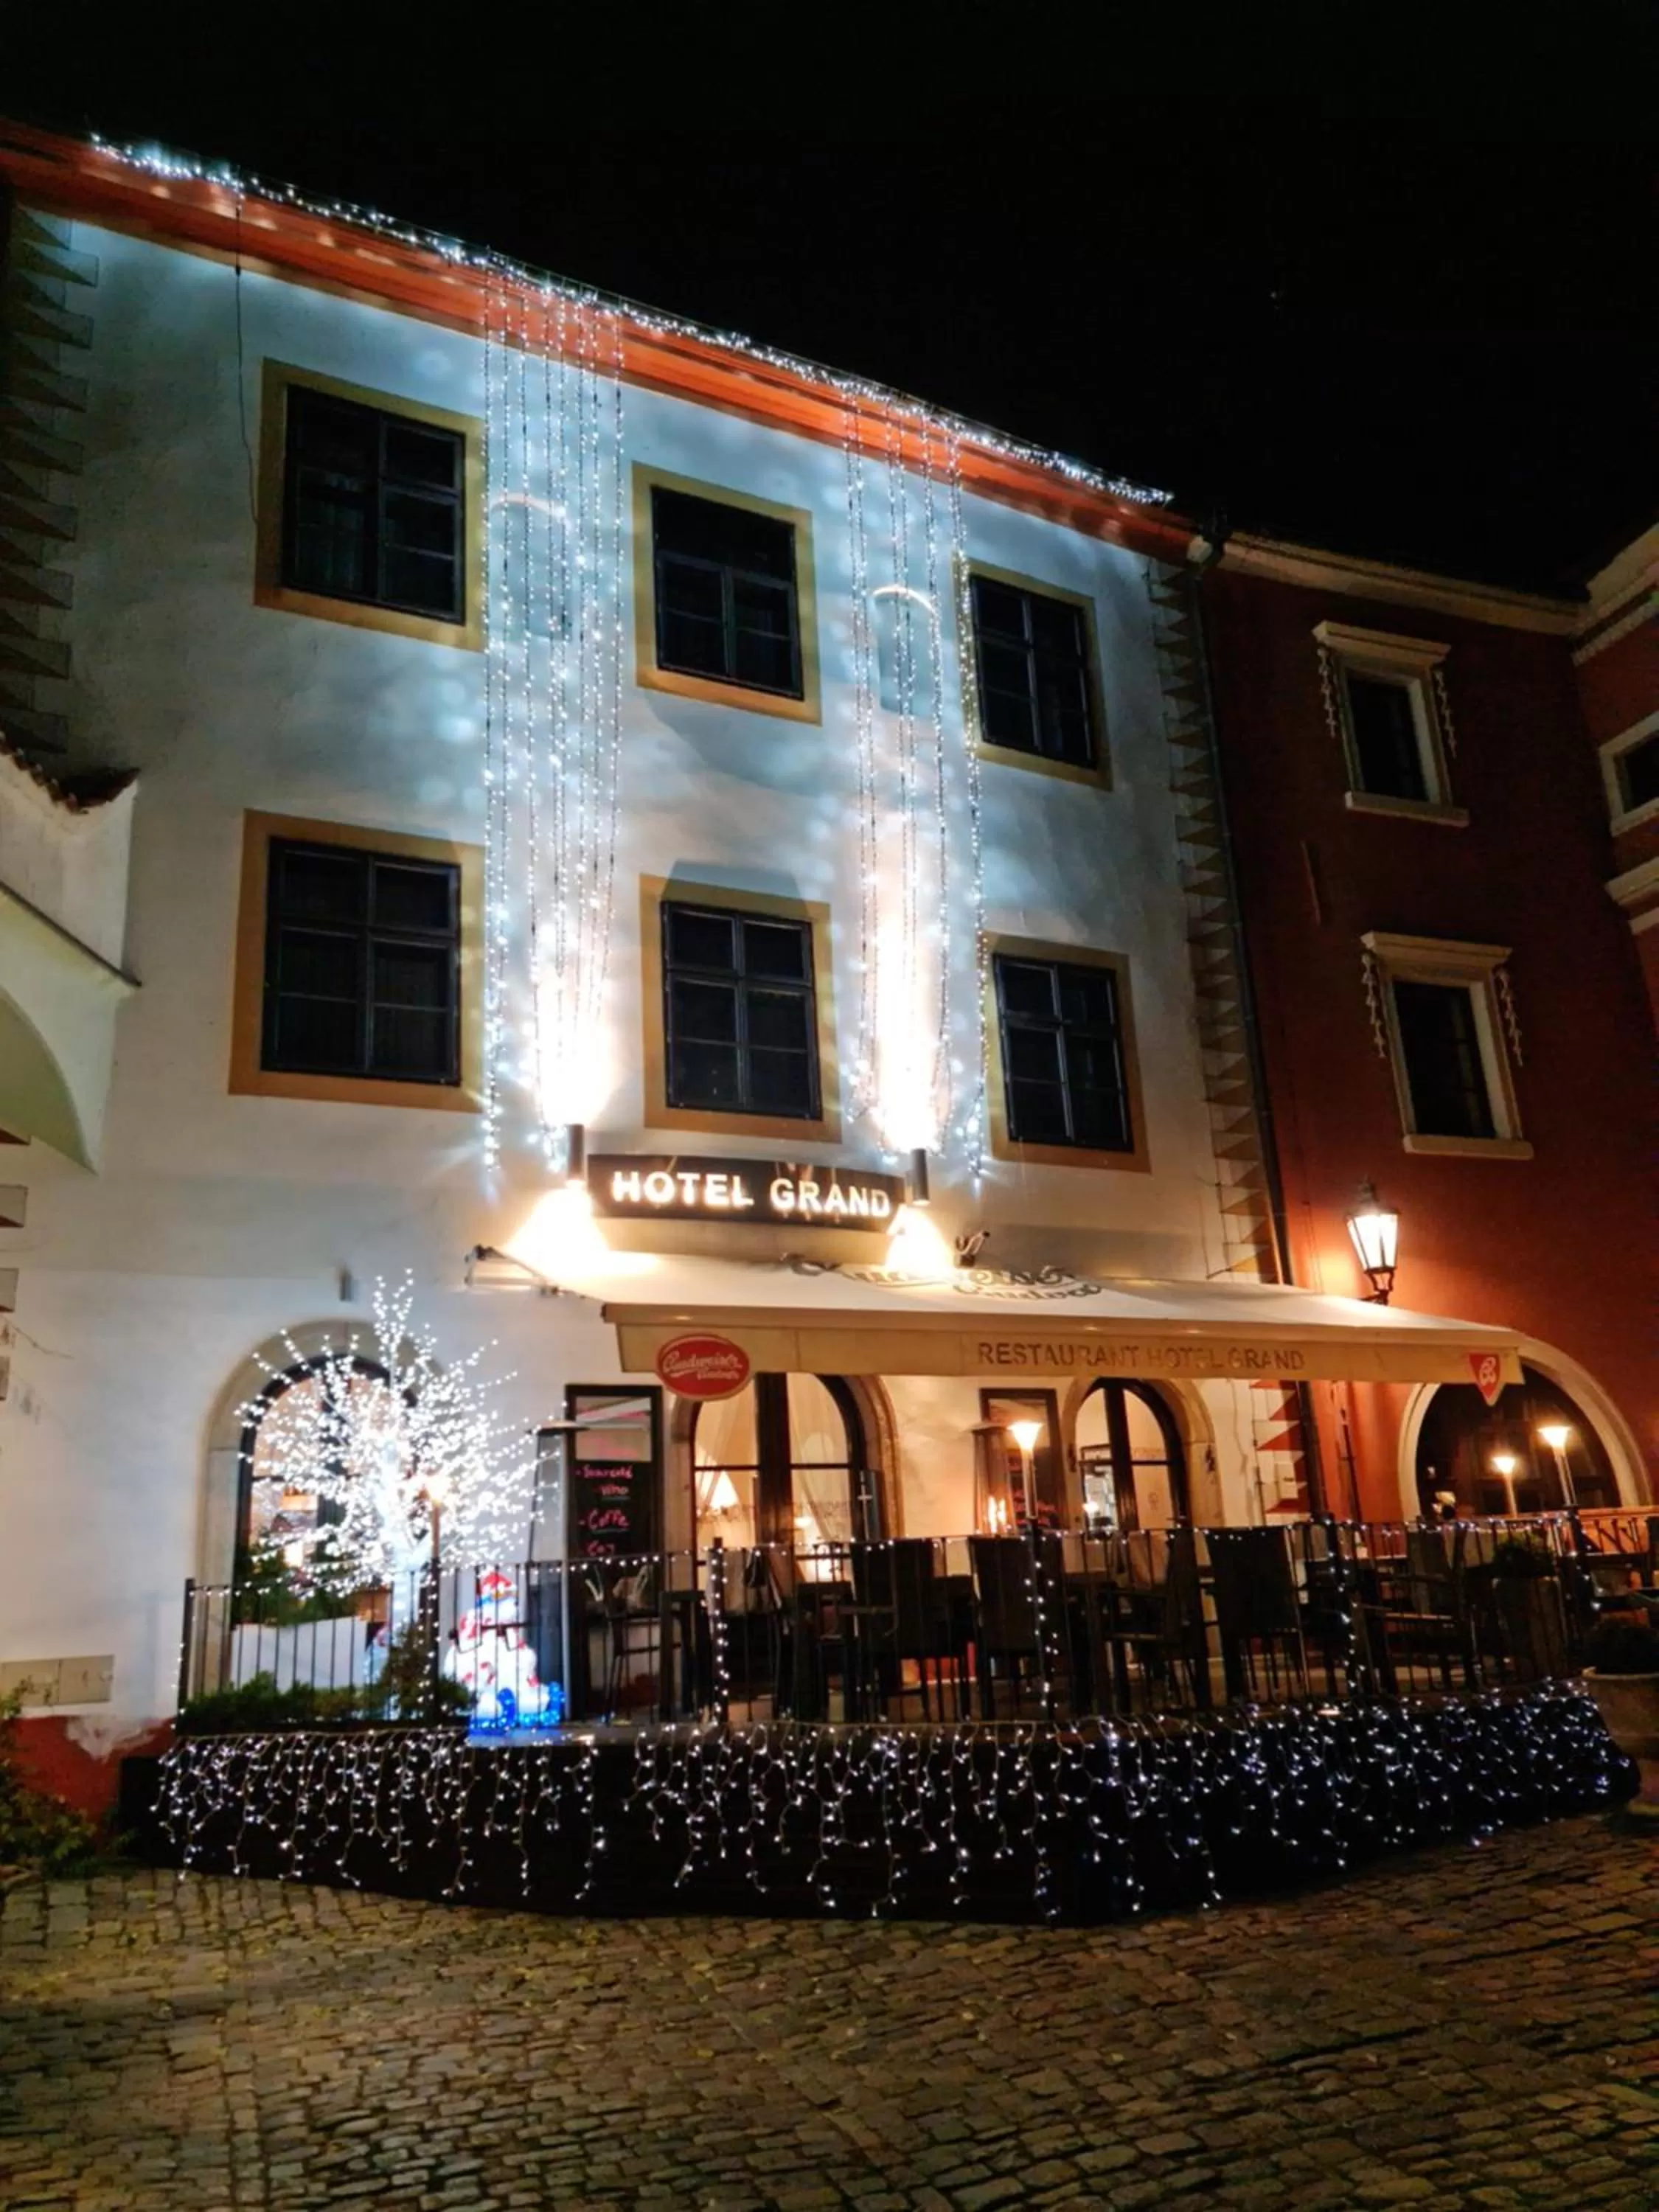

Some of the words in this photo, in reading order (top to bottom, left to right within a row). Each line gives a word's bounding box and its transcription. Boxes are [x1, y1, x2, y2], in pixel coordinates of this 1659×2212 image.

[611, 1170, 754, 1207] HOTEL
[770, 1178, 891, 1218] GRAND
[978, 1342, 1139, 1368] RESTAURANT
[1147, 1346, 1223, 1369] HOTEL
[1227, 1348, 1305, 1371] GRAND
